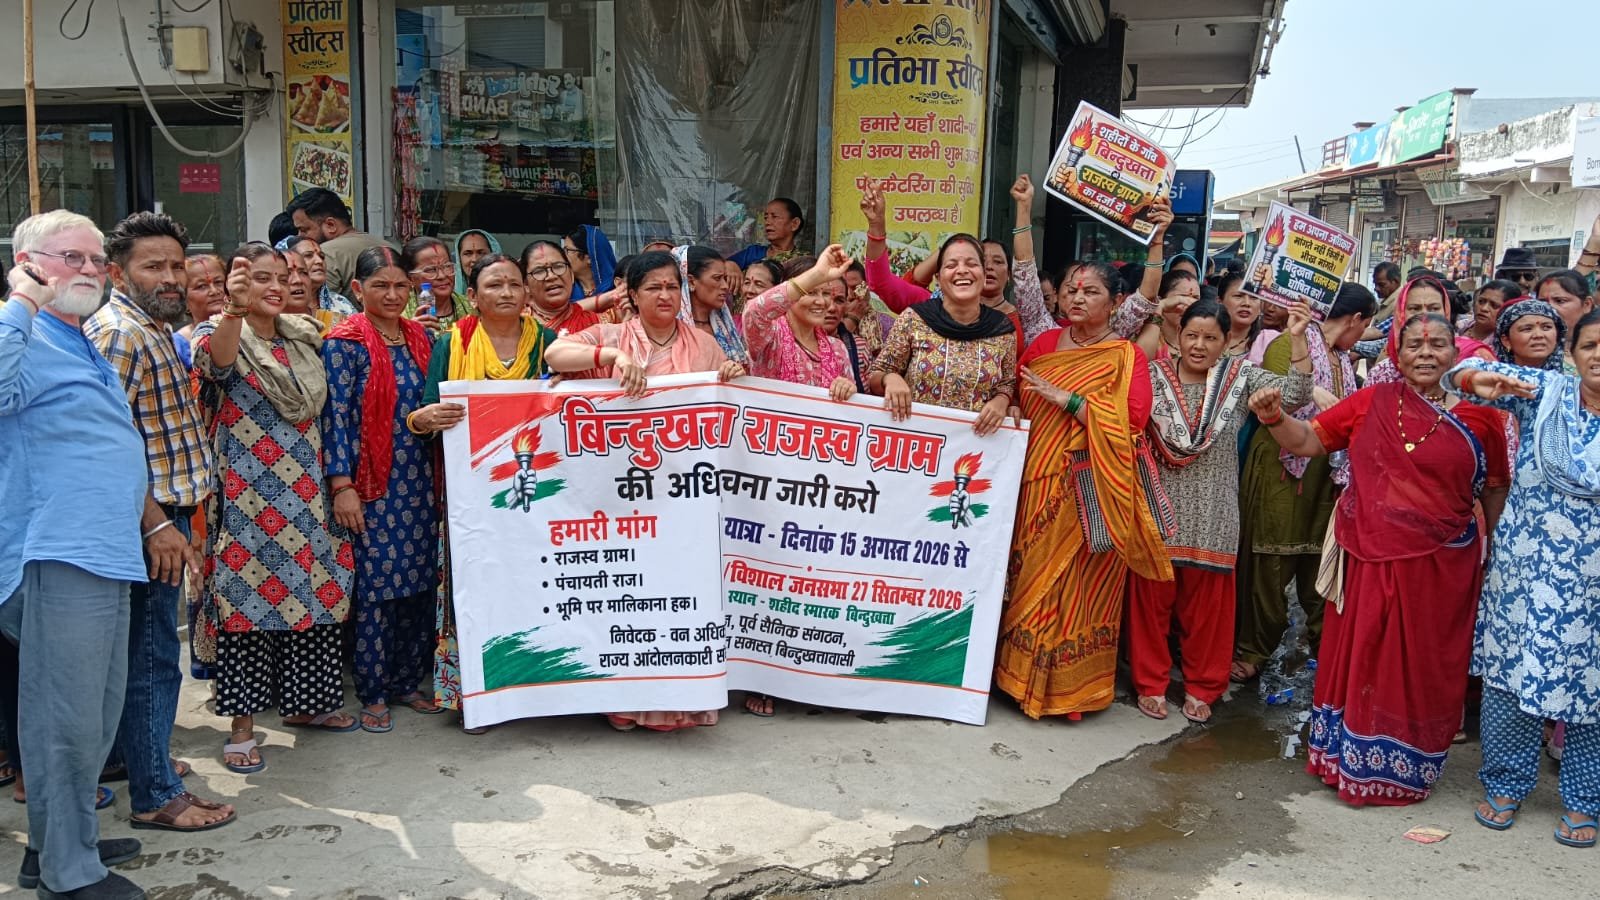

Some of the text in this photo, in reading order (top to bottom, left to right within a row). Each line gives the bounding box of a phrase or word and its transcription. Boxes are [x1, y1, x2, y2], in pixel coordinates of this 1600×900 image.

[287, 27, 345, 56] स्वीट्स
[849, 47, 983, 97] प्रतिभा स्वीट्स
[860, 112, 900, 133] हमारे
[904, 112, 937, 133] यहाँ
[841, 139, 865, 159] एवं
[867, 144, 904, 159] अन्य
[908, 140, 941, 159] सभी
[945, 146, 964, 168] शुभ
[1129, 139, 1141, 153] के
[880, 173, 936, 193] कैटरिंग
[940, 174, 956, 193] की
[1082, 168, 1141, 204] राजस्व ग्राम
[895, 207, 948, 222] उपलब्ध
[559, 395, 946, 477] बिन्दुखत्ता राजस्व ग्राम
[615, 466, 655, 501] की
[776, 473, 830, 508] जारी
[834, 480, 880, 514] करो
[548, 509, 658, 546] हमारी मांग
[724, 516, 766, 544] यात्रा
[780, 520, 837, 554] दिनांक
[840, 531, 857, 556] 15
[860, 535, 912, 562] अगस्त
[912, 539, 950, 566] 2026
[953, 540, 970, 569] से
[554, 548, 636, 566] राजस्व ग्राम।
[554, 569, 643, 591] पंचायती राज।
[788, 575, 850, 600] जनसभा
[851, 580, 868, 602] 27
[871, 578, 926, 607] सितम्बर
[927, 588, 963, 611] 2026
[556, 594, 697, 621] भूमि पर मालिकाना हक।
[728, 590, 758, 606] स्थान
[769, 597, 802, 615] शहीद
[803, 603, 842, 620] स्मारक
[846, 604, 897, 628] बिन्दुखत्ता
[610, 624, 657, 644] निवेदक
[670, 627, 690, 642] वन
[739, 613, 759, 634] पूर्व
[760, 615, 800, 639] सैनिक
[802, 626, 847, 648] संगठन,
[599, 652, 630, 668] राज्य
[633, 645, 713, 667] आंदोलनकारी
[734, 635, 772, 656] समस्त
[775, 649, 855, 668] बिन्दुखत्तावासी
